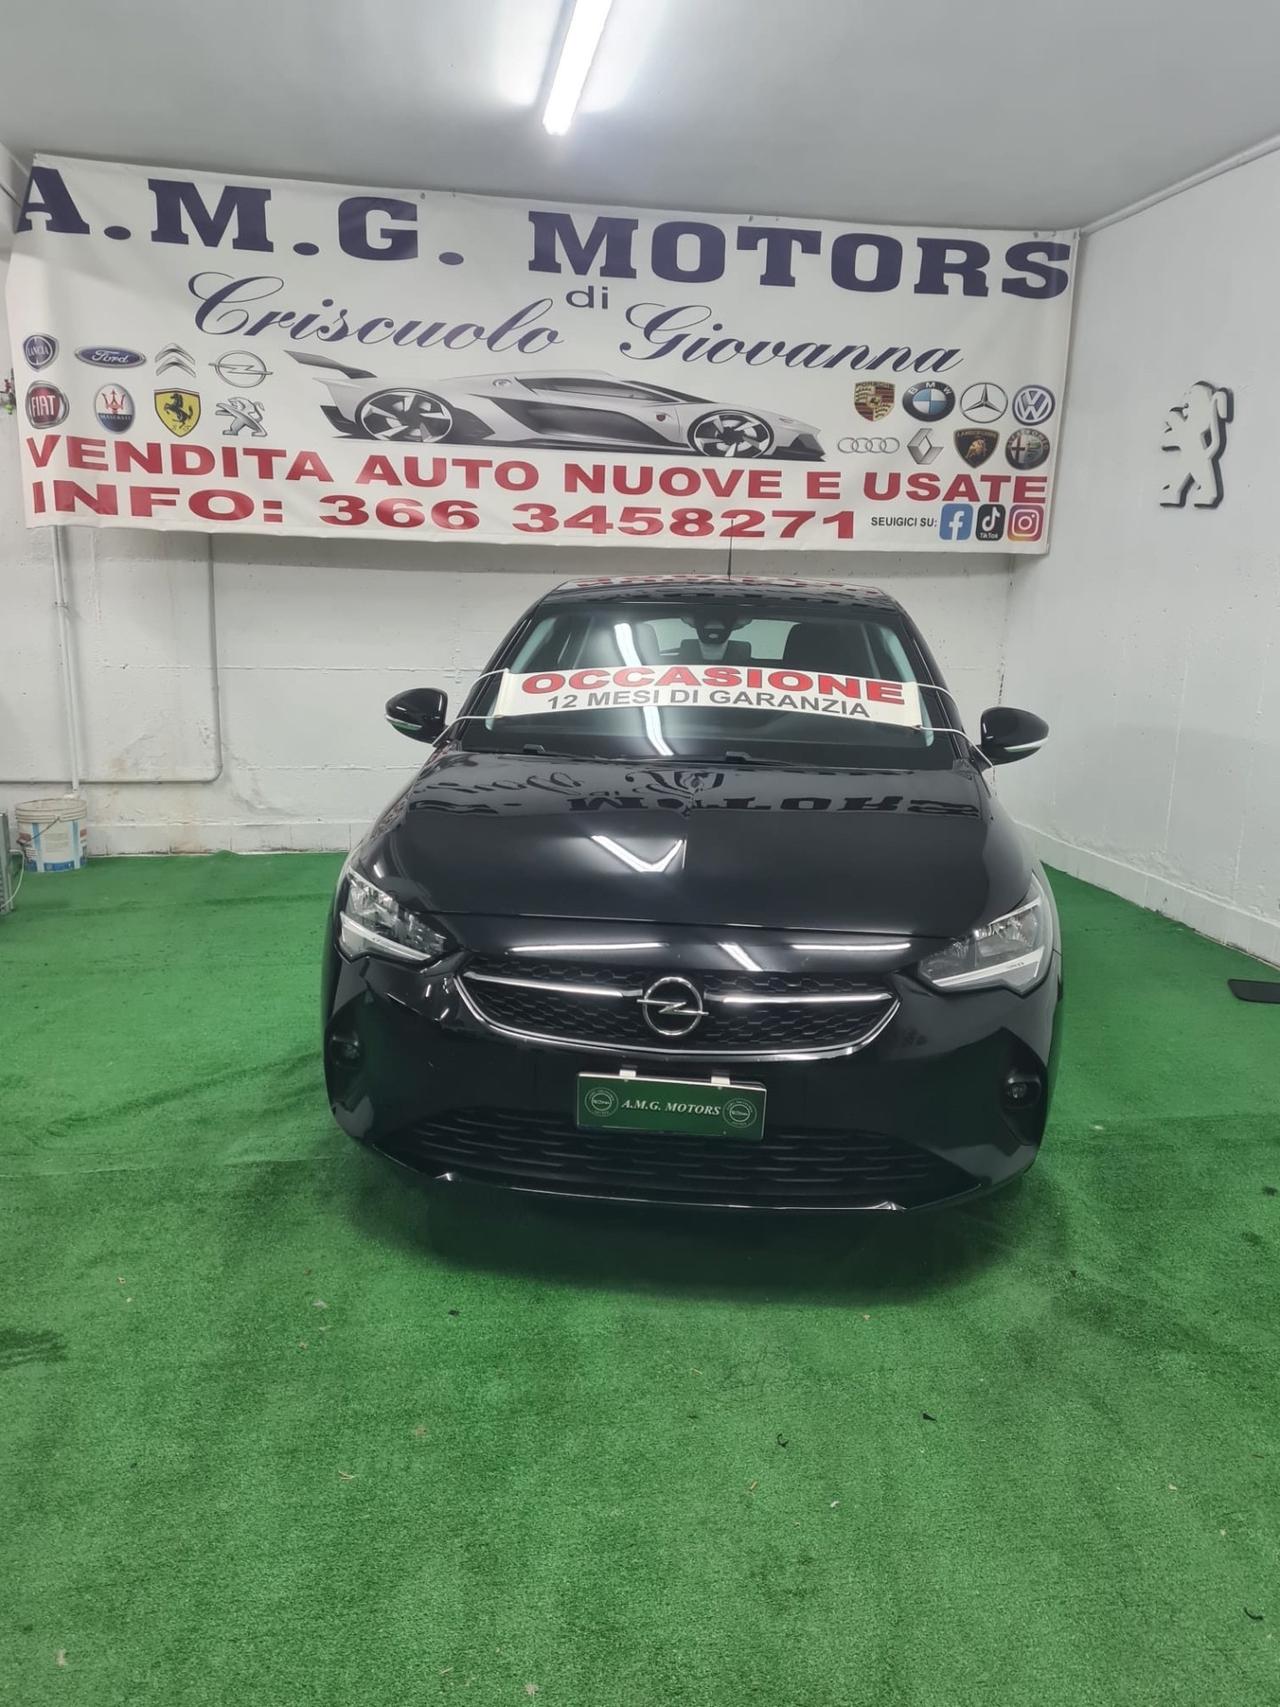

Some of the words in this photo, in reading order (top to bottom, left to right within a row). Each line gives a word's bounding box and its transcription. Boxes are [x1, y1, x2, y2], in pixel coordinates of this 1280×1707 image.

[16, 166, 465, 266] A.M.G.
[528, 210, 1071, 300] MOTORS
[566, 286, 609, 310] di
[188, 271, 565, 354] Criscuolo
[619, 302, 964, 374] Giovanna
[91, 349, 128, 363] Ford
[907, 382, 952, 395] BMW
[31, 395, 56, 417] FIAT
[26, 435, 334, 482] VENDITA
[356, 455, 539, 491] AUTO
[564, 463, 782, 499] NUOVE
[806, 471, 841, 499] E
[863, 472, 1047, 504] USATE
[32, 480, 283, 523] INFO:
[319, 494, 480, 531] 366
[512, 502, 855, 539] 3458271
[920, 517, 938, 527] SU:
[522, 667, 905, 705] OCCASIONE
[547, 695, 576, 710] 12
[587, 690, 660, 706] MESI
[670, 689, 699, 704] DI
[708, 690, 870, 718] GARANZIA
[621, 1100, 661, 1111] A.M.G.
[665, 1103, 721, 1116] MOTORS
